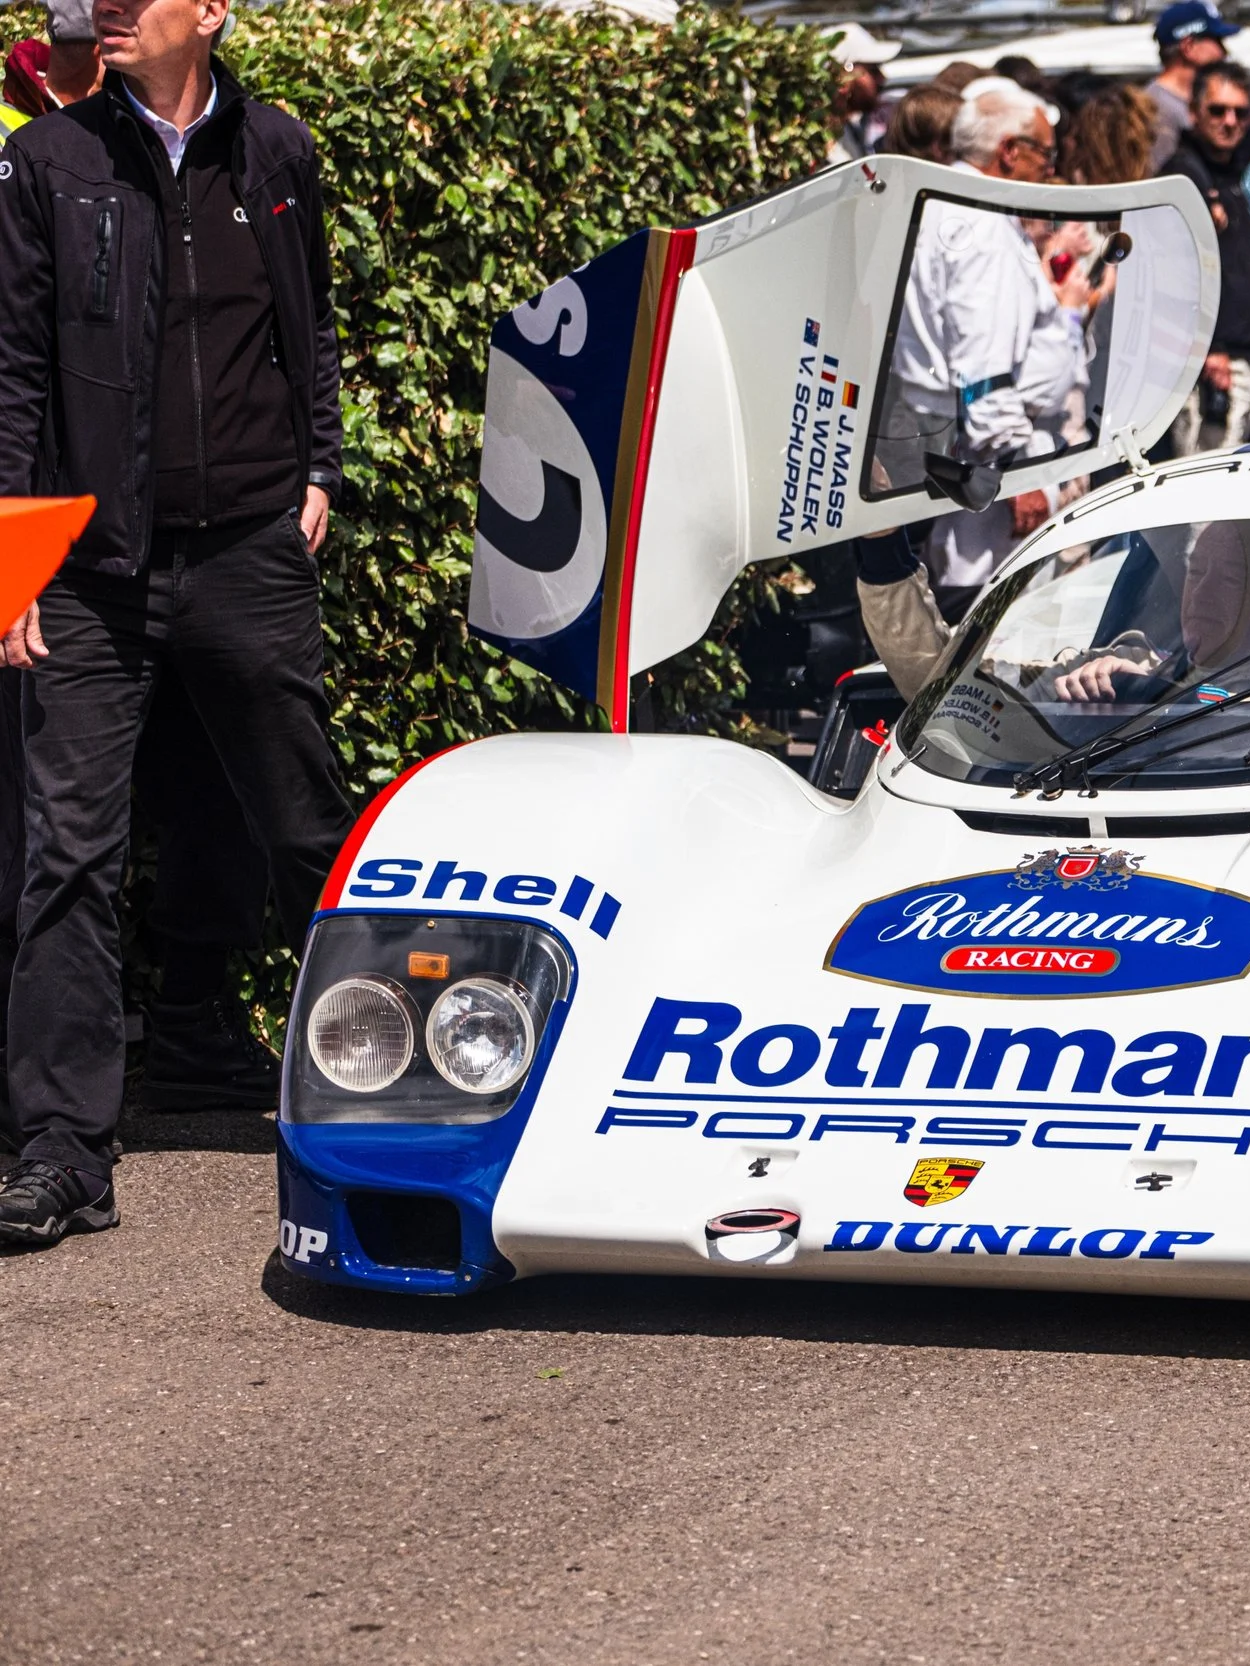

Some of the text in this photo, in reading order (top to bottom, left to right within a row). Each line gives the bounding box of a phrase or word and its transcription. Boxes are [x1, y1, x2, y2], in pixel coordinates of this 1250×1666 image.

[776, 355, 816, 543] V. SCHUPPAN
[800, 386, 835, 536] B. WOLLEK
[826, 413, 854, 529] J. MASS
[349, 858, 622, 940] Shell
[876, 891, 1221, 949] Rothmans
[965, 949, 1096, 971] RACING
[918, 1159, 981, 1168] PORSCHE
[823, 1220, 1215, 1260] DUNLOP
